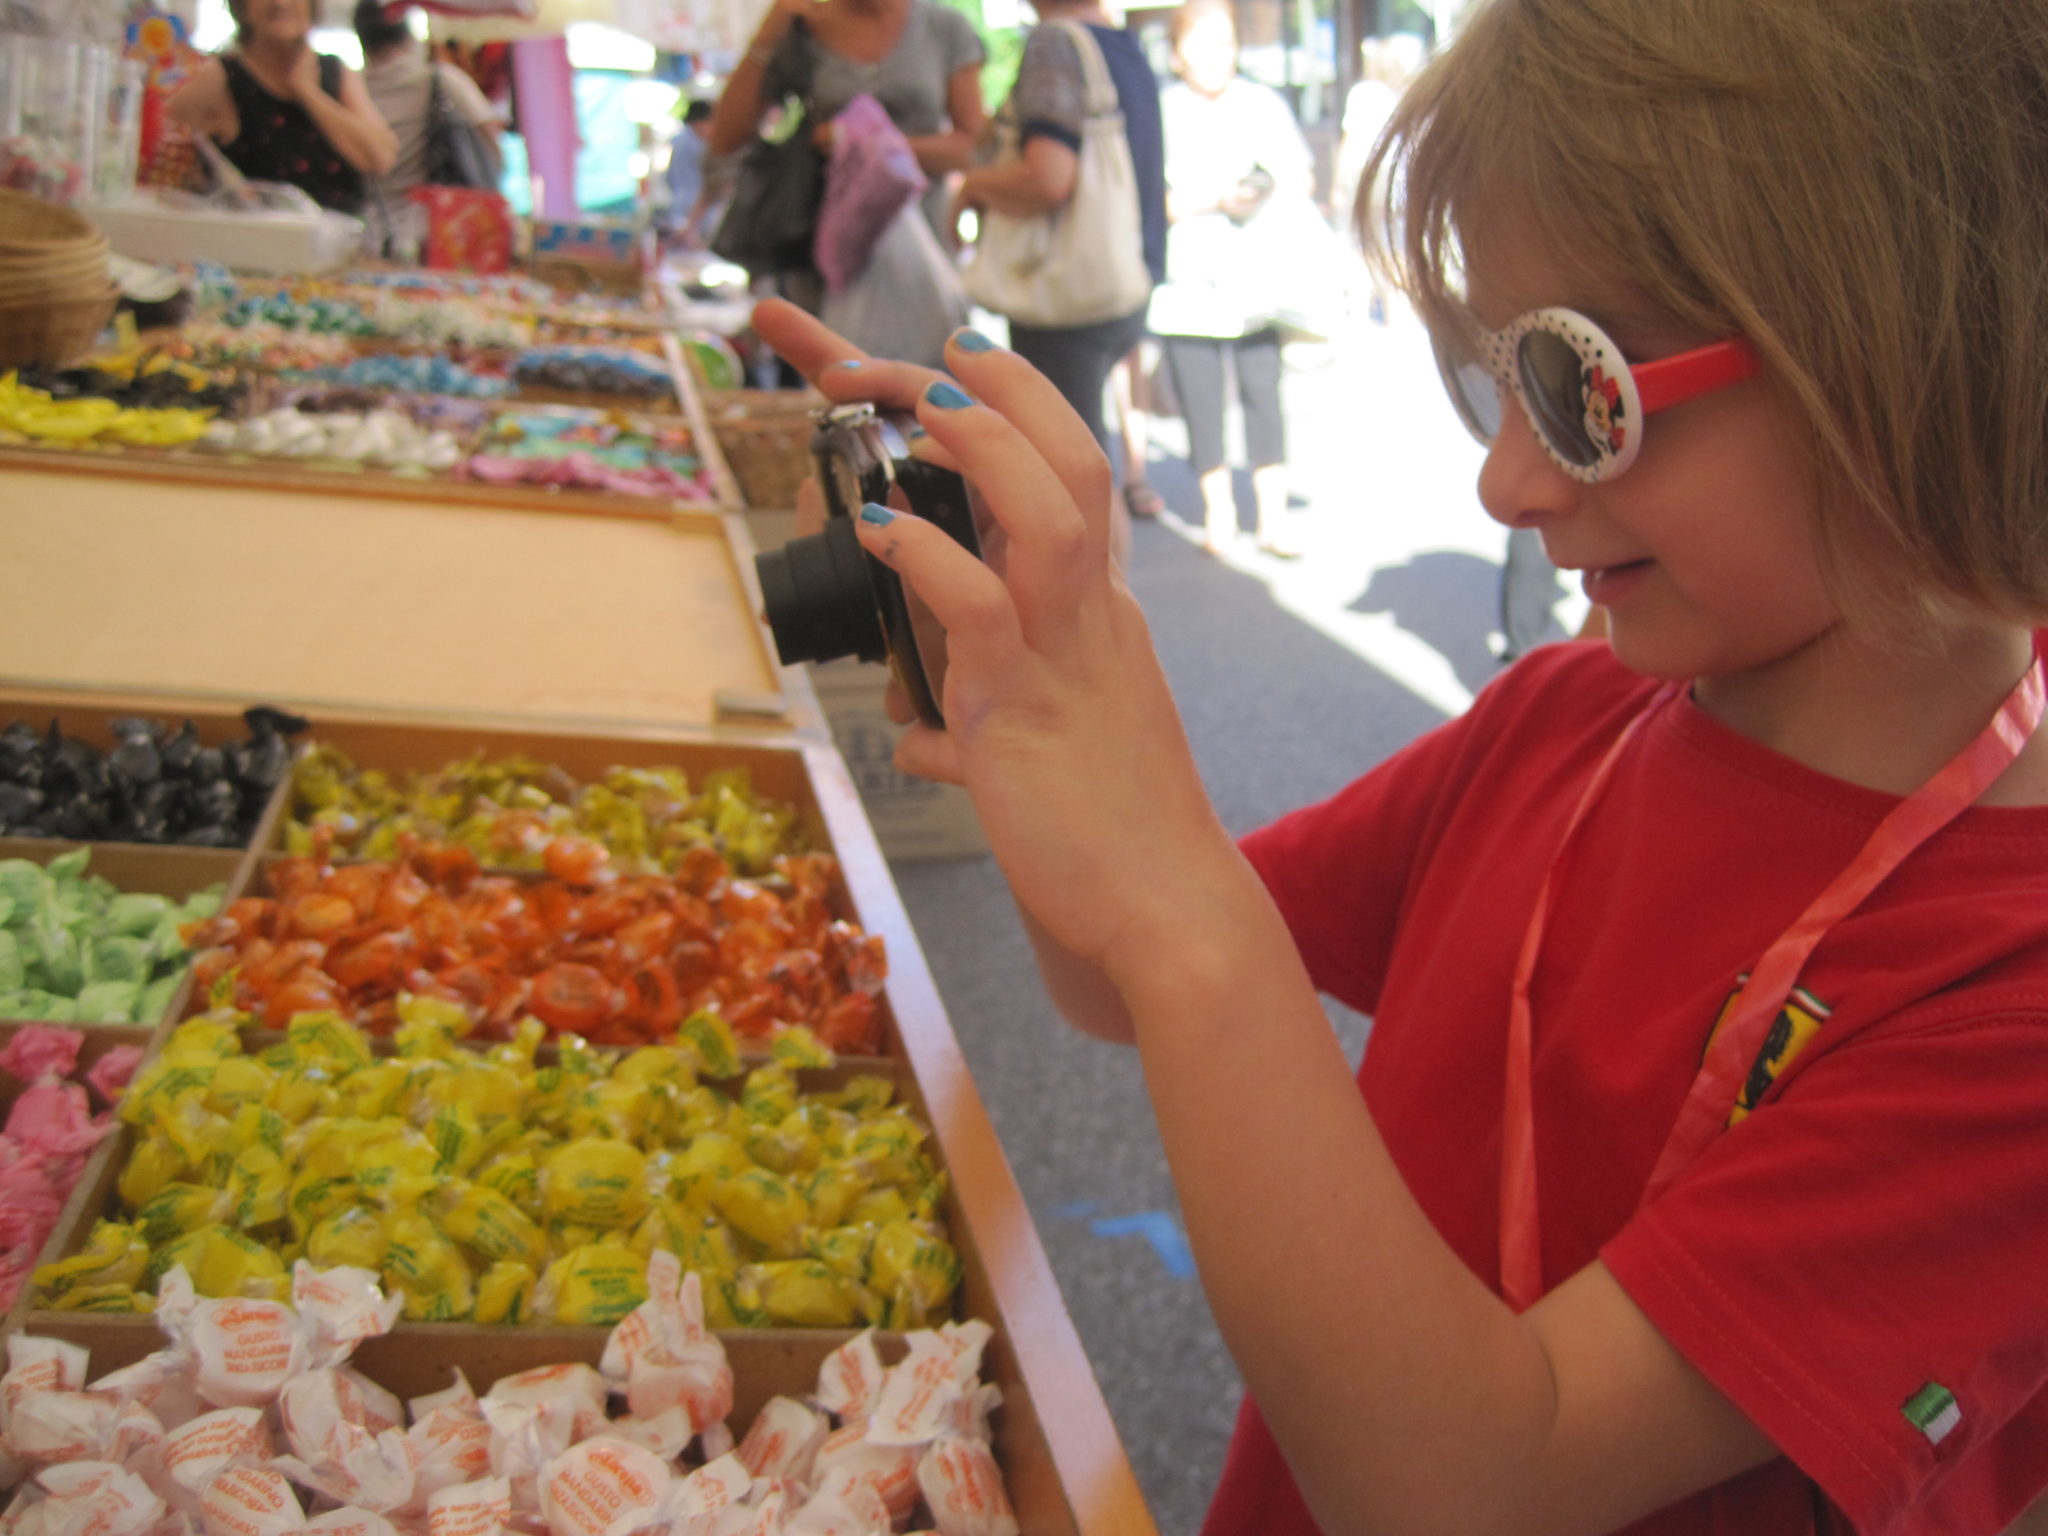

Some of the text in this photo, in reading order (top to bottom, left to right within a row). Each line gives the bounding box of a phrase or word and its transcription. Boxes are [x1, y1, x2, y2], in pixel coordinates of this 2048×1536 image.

[237, 1331, 281, 1346] GUSTO
[559, 1470, 613, 1526] MANDARIN
[583, 1471, 620, 1508] GUSTO
